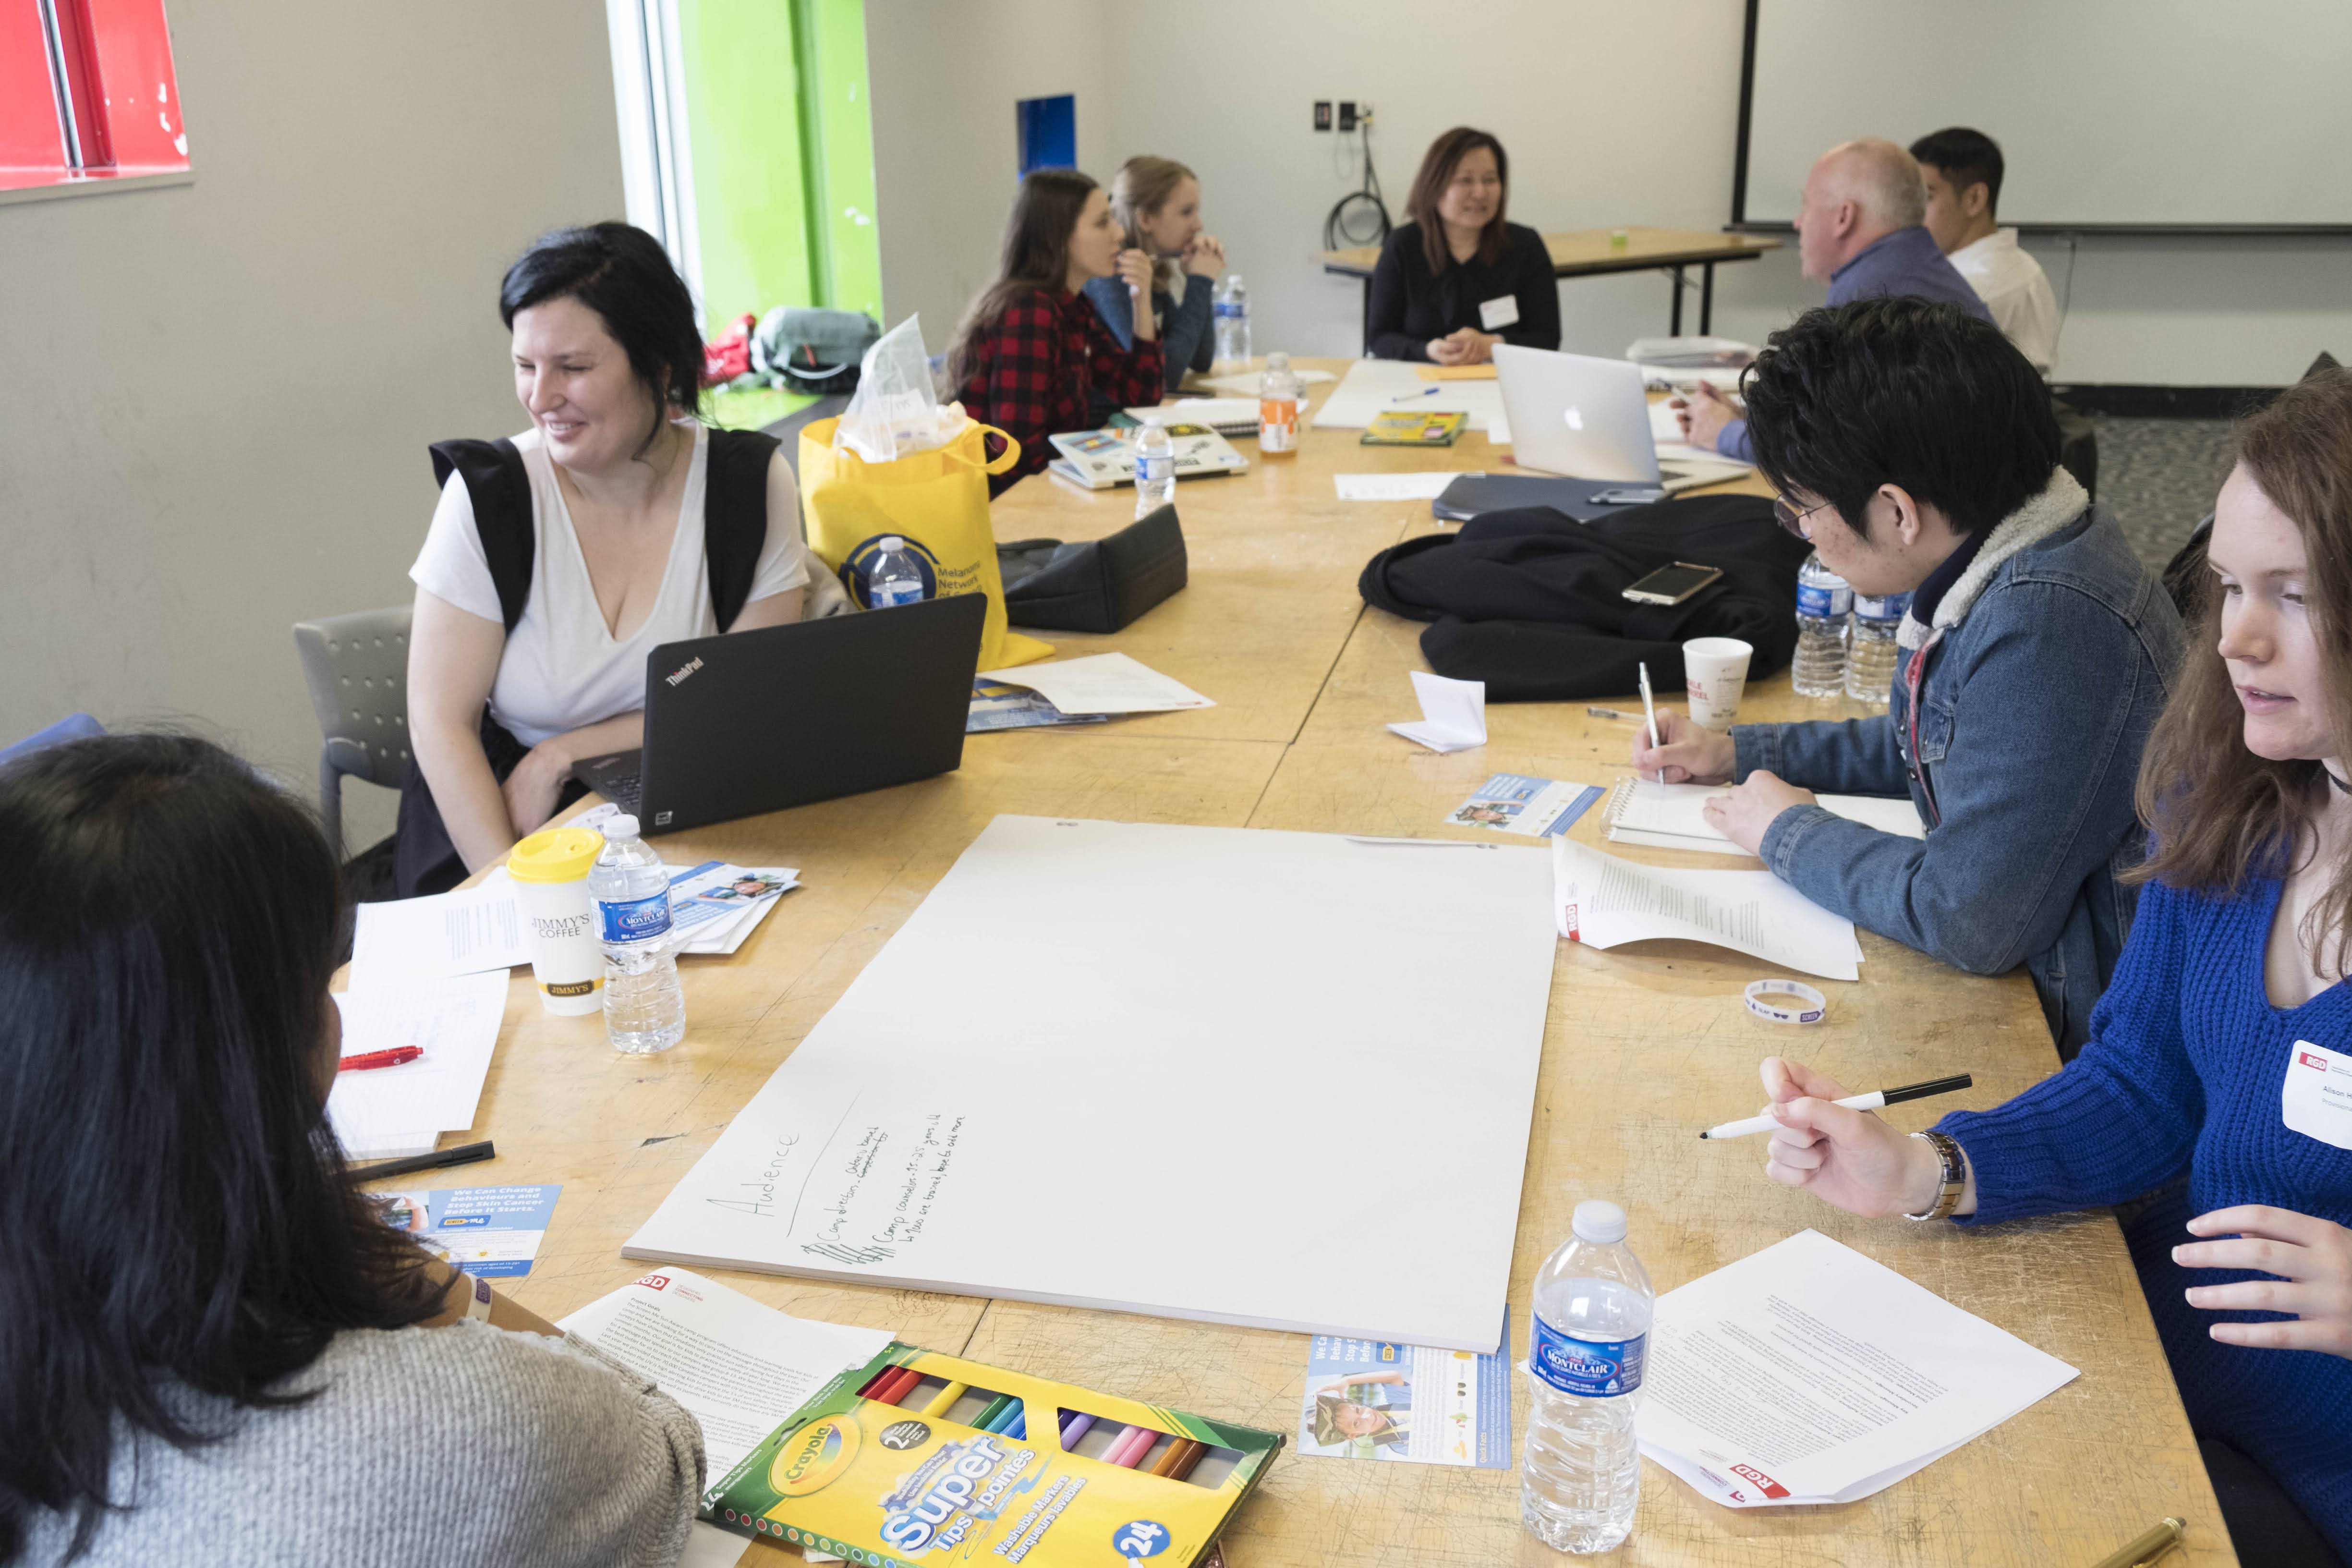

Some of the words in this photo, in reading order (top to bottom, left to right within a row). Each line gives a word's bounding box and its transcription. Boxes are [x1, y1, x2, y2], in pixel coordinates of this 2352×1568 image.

[938, 560, 980, 576] Melanoma
[938, 574, 977, 588] Network
[665, 657, 704, 687] ThinkPad
[531, 913, 589, 930] JIMMY'S
[626, 909, 665, 924] MONTCLAIR
[1564, 905, 1579, 932] RGD
[539, 926, 581, 939] COFFEE
[551, 983, 589, 996] JIMMY'S
[2306, 1056, 2326, 1070] RGD
[706, 1132, 800, 1217] Audience
[817, 1217, 846, 1241] Camp
[872, 1215, 904, 1242] Camp
[630, 1297, 647, 1307] Project
[648, 1303, 661, 1312] Goals
[636, 1305, 652, 1315] Screen
[669, 1320, 685, 1329] Aware
[684, 1327, 697, 1336] camp
[697, 1333, 717, 1345] program
[660, 1323, 678, 1334] looking
[648, 1324, 664, 1333] shown
[696, 1346, 707, 1354] only
[707, 1350, 726, 1362] practice
[661, 1337, 673, 1346] goal
[700, 1355, 719, 1366] practice
[1316, 1346, 1326, 1360] We
[1345, 1344, 1358, 1361] Stop
[1547, 1349, 1608, 1374] MONTCLAIR
[884, 1436, 909, 1449] 2
[1479, 1431, 1487, 1446] Facts
[784, 1426, 831, 1480] Crayola
[1478, 1446, 1487, 1463] Quick
[1735, 1466, 1774, 1489] RGD
[701, 1492, 724, 1512] 24
[886, 1436, 1005, 1550] Super
[931, 1515, 974, 1551] Tips
[977, 1449, 1036, 1507] pointes
[993, 1511, 1038, 1555] Washable
[1032, 1475, 1070, 1511] Markers
[1006, 1514, 1056, 1564] Marqueurs
[1055, 1478, 1087, 1515] lavables
[1120, 1522, 1163, 1556] 24
